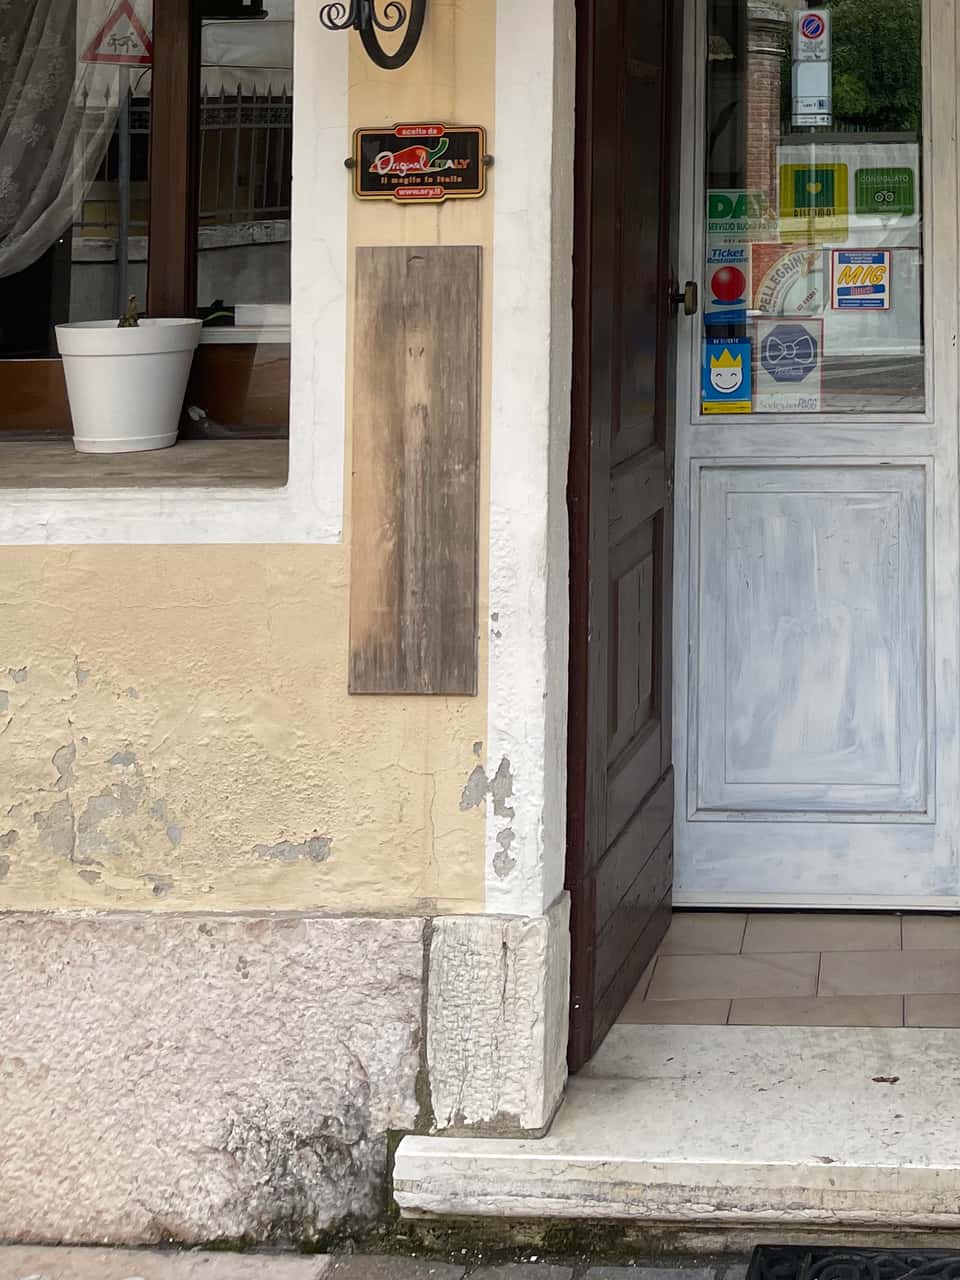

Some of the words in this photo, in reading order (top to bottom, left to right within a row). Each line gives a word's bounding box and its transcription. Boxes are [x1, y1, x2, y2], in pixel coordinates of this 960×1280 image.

[434, 159, 470, 169] ITALY
[711, 248, 745, 258] Ticket
[759, 253, 806, 313] PELLEGRINI
[837, 265, 887, 286] MIG
